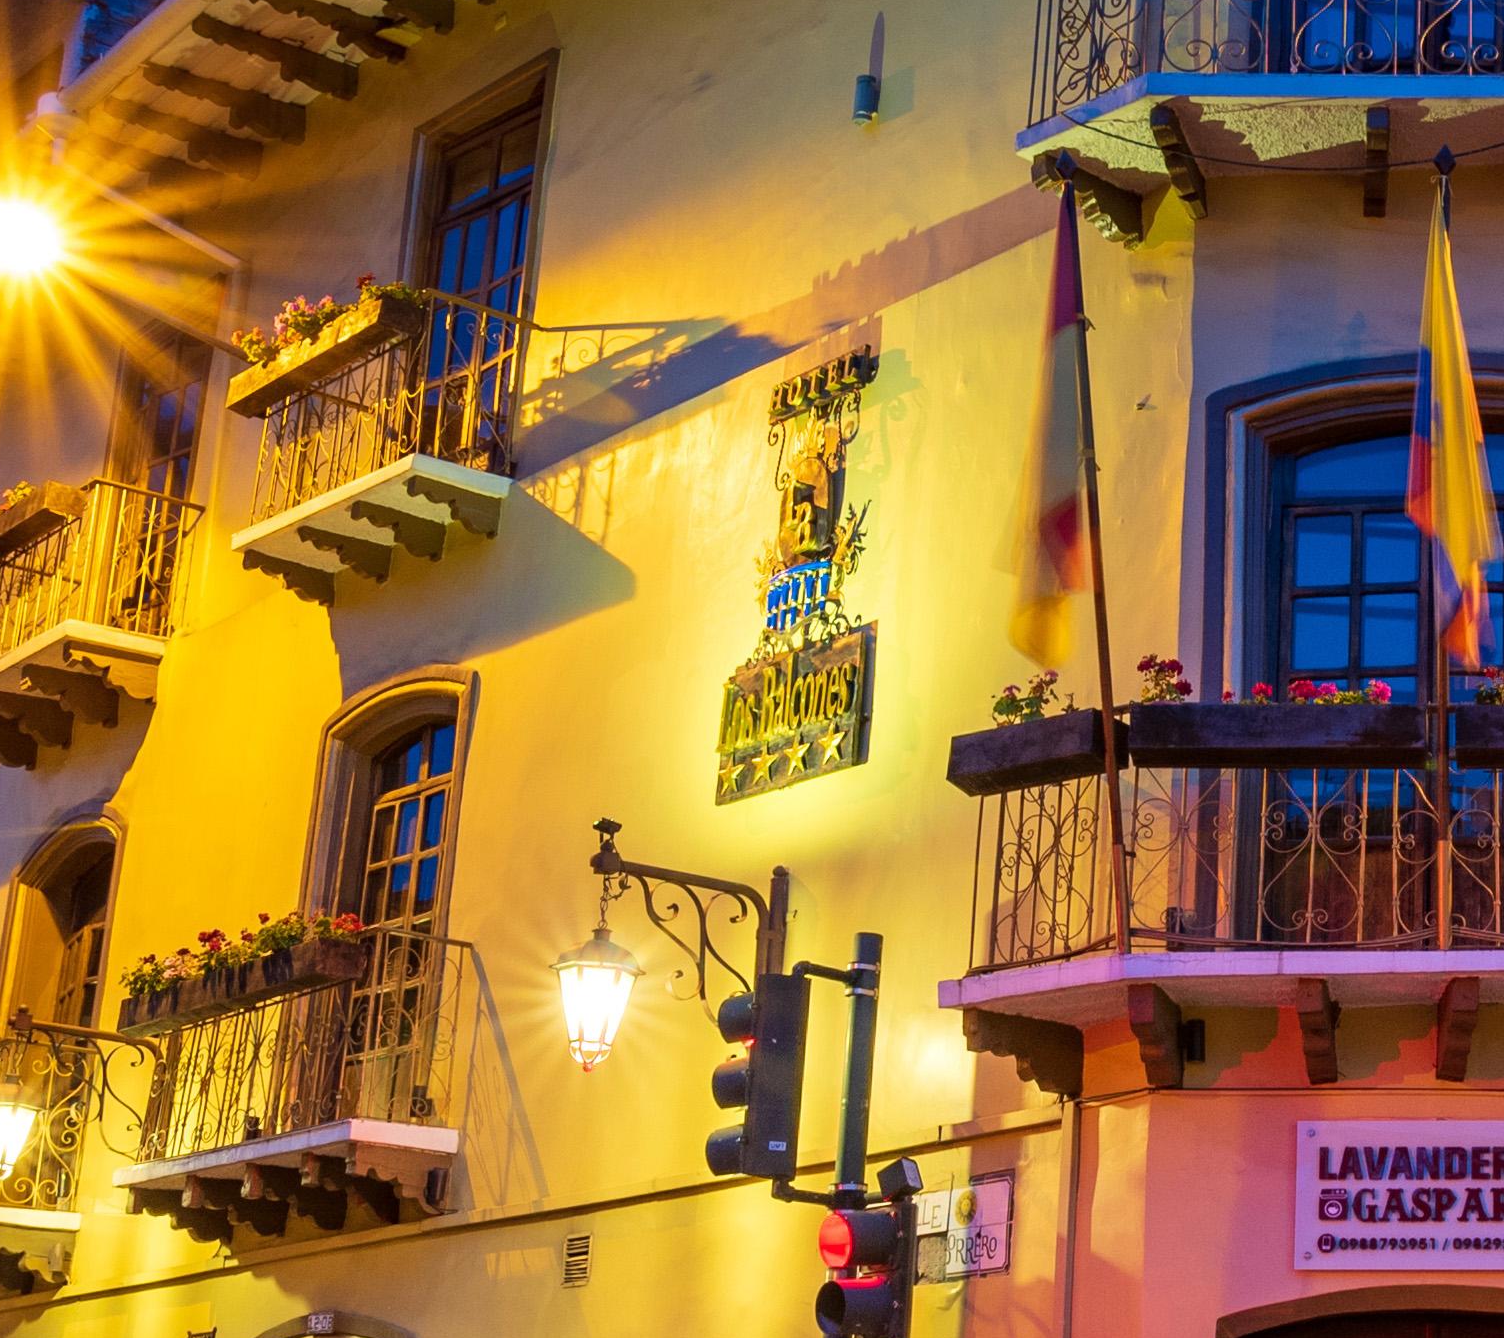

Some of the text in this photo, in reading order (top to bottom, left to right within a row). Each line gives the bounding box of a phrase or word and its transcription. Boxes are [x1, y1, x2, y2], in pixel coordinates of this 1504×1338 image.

[770, 351, 859, 415] HOTEL
[715, 651, 853, 753] Los Balcones
